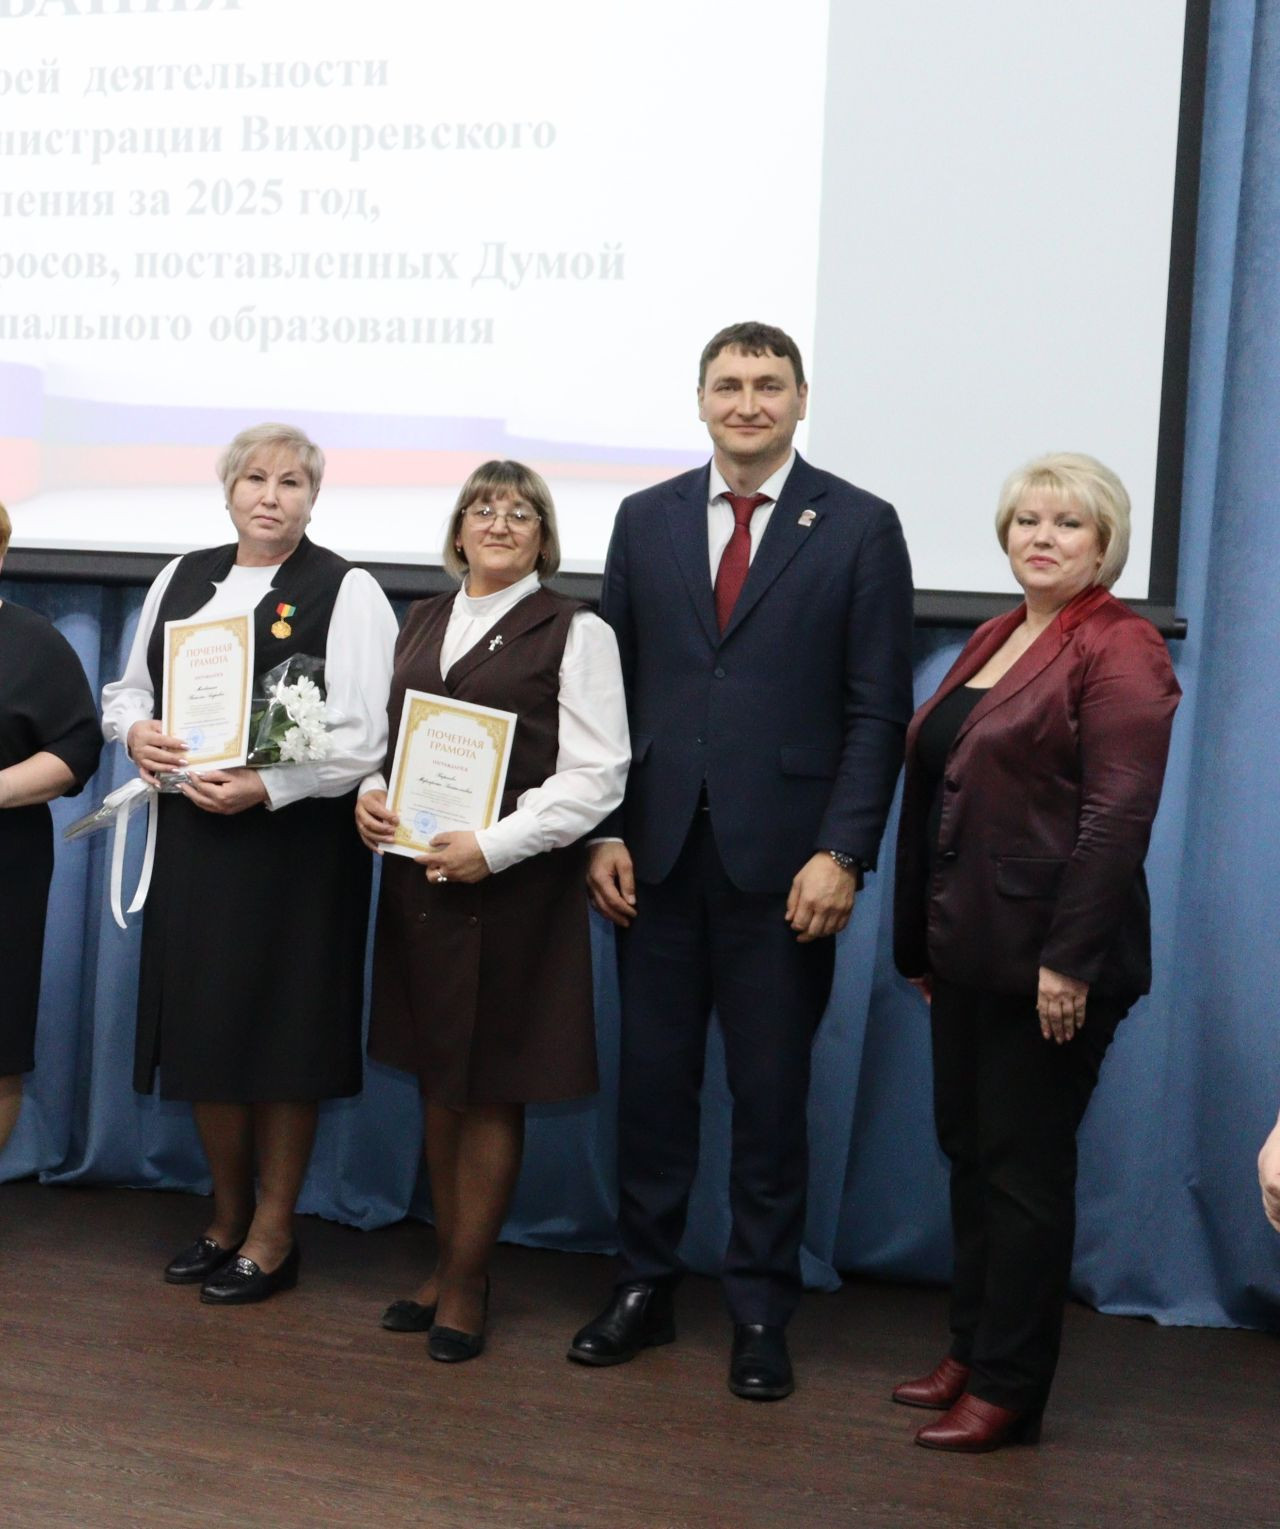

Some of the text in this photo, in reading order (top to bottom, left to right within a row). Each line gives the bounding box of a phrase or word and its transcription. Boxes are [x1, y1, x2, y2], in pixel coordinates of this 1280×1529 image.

[83, 57, 390, 97] деятельности
[240, 114, 558, 163] Вихоревского
[128, 189, 171, 217] за
[185, 177, 285, 216] 2025
[299, 187, 382, 223] год,
[134, 250, 459, 281] поставленных
[470, 240, 627, 291] Думой
[208, 304, 496, 352] образования
[426, 727, 486, 751] ПОЧЕТНАЯ
[429, 740, 478, 761] ГРАМОТА
